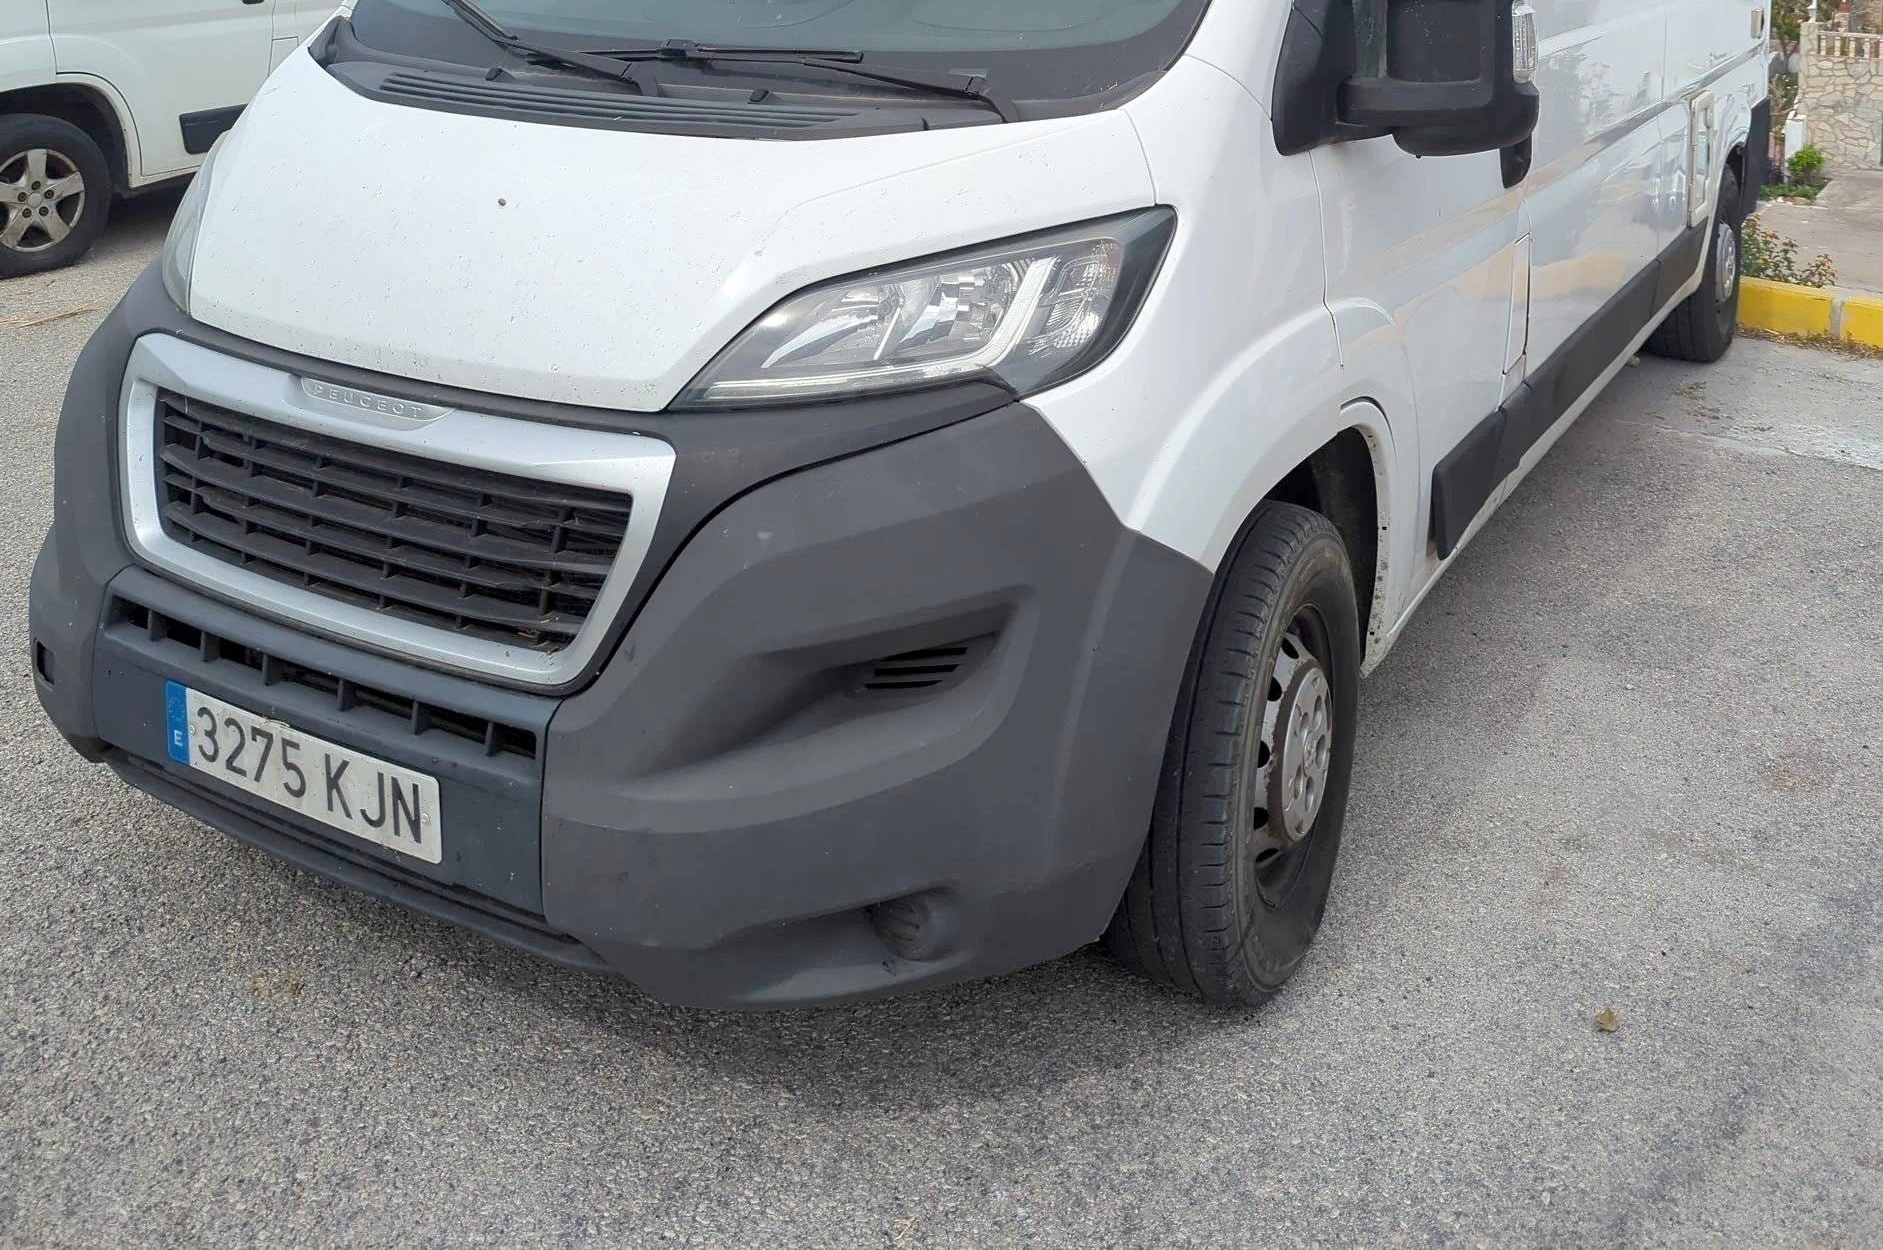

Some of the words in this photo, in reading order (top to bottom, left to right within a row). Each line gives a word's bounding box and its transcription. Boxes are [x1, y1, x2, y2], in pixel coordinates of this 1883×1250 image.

[314, 383, 422, 418] PEUGEOT
[197, 706, 306, 799] 3275
[324, 753, 422, 844] KJN
